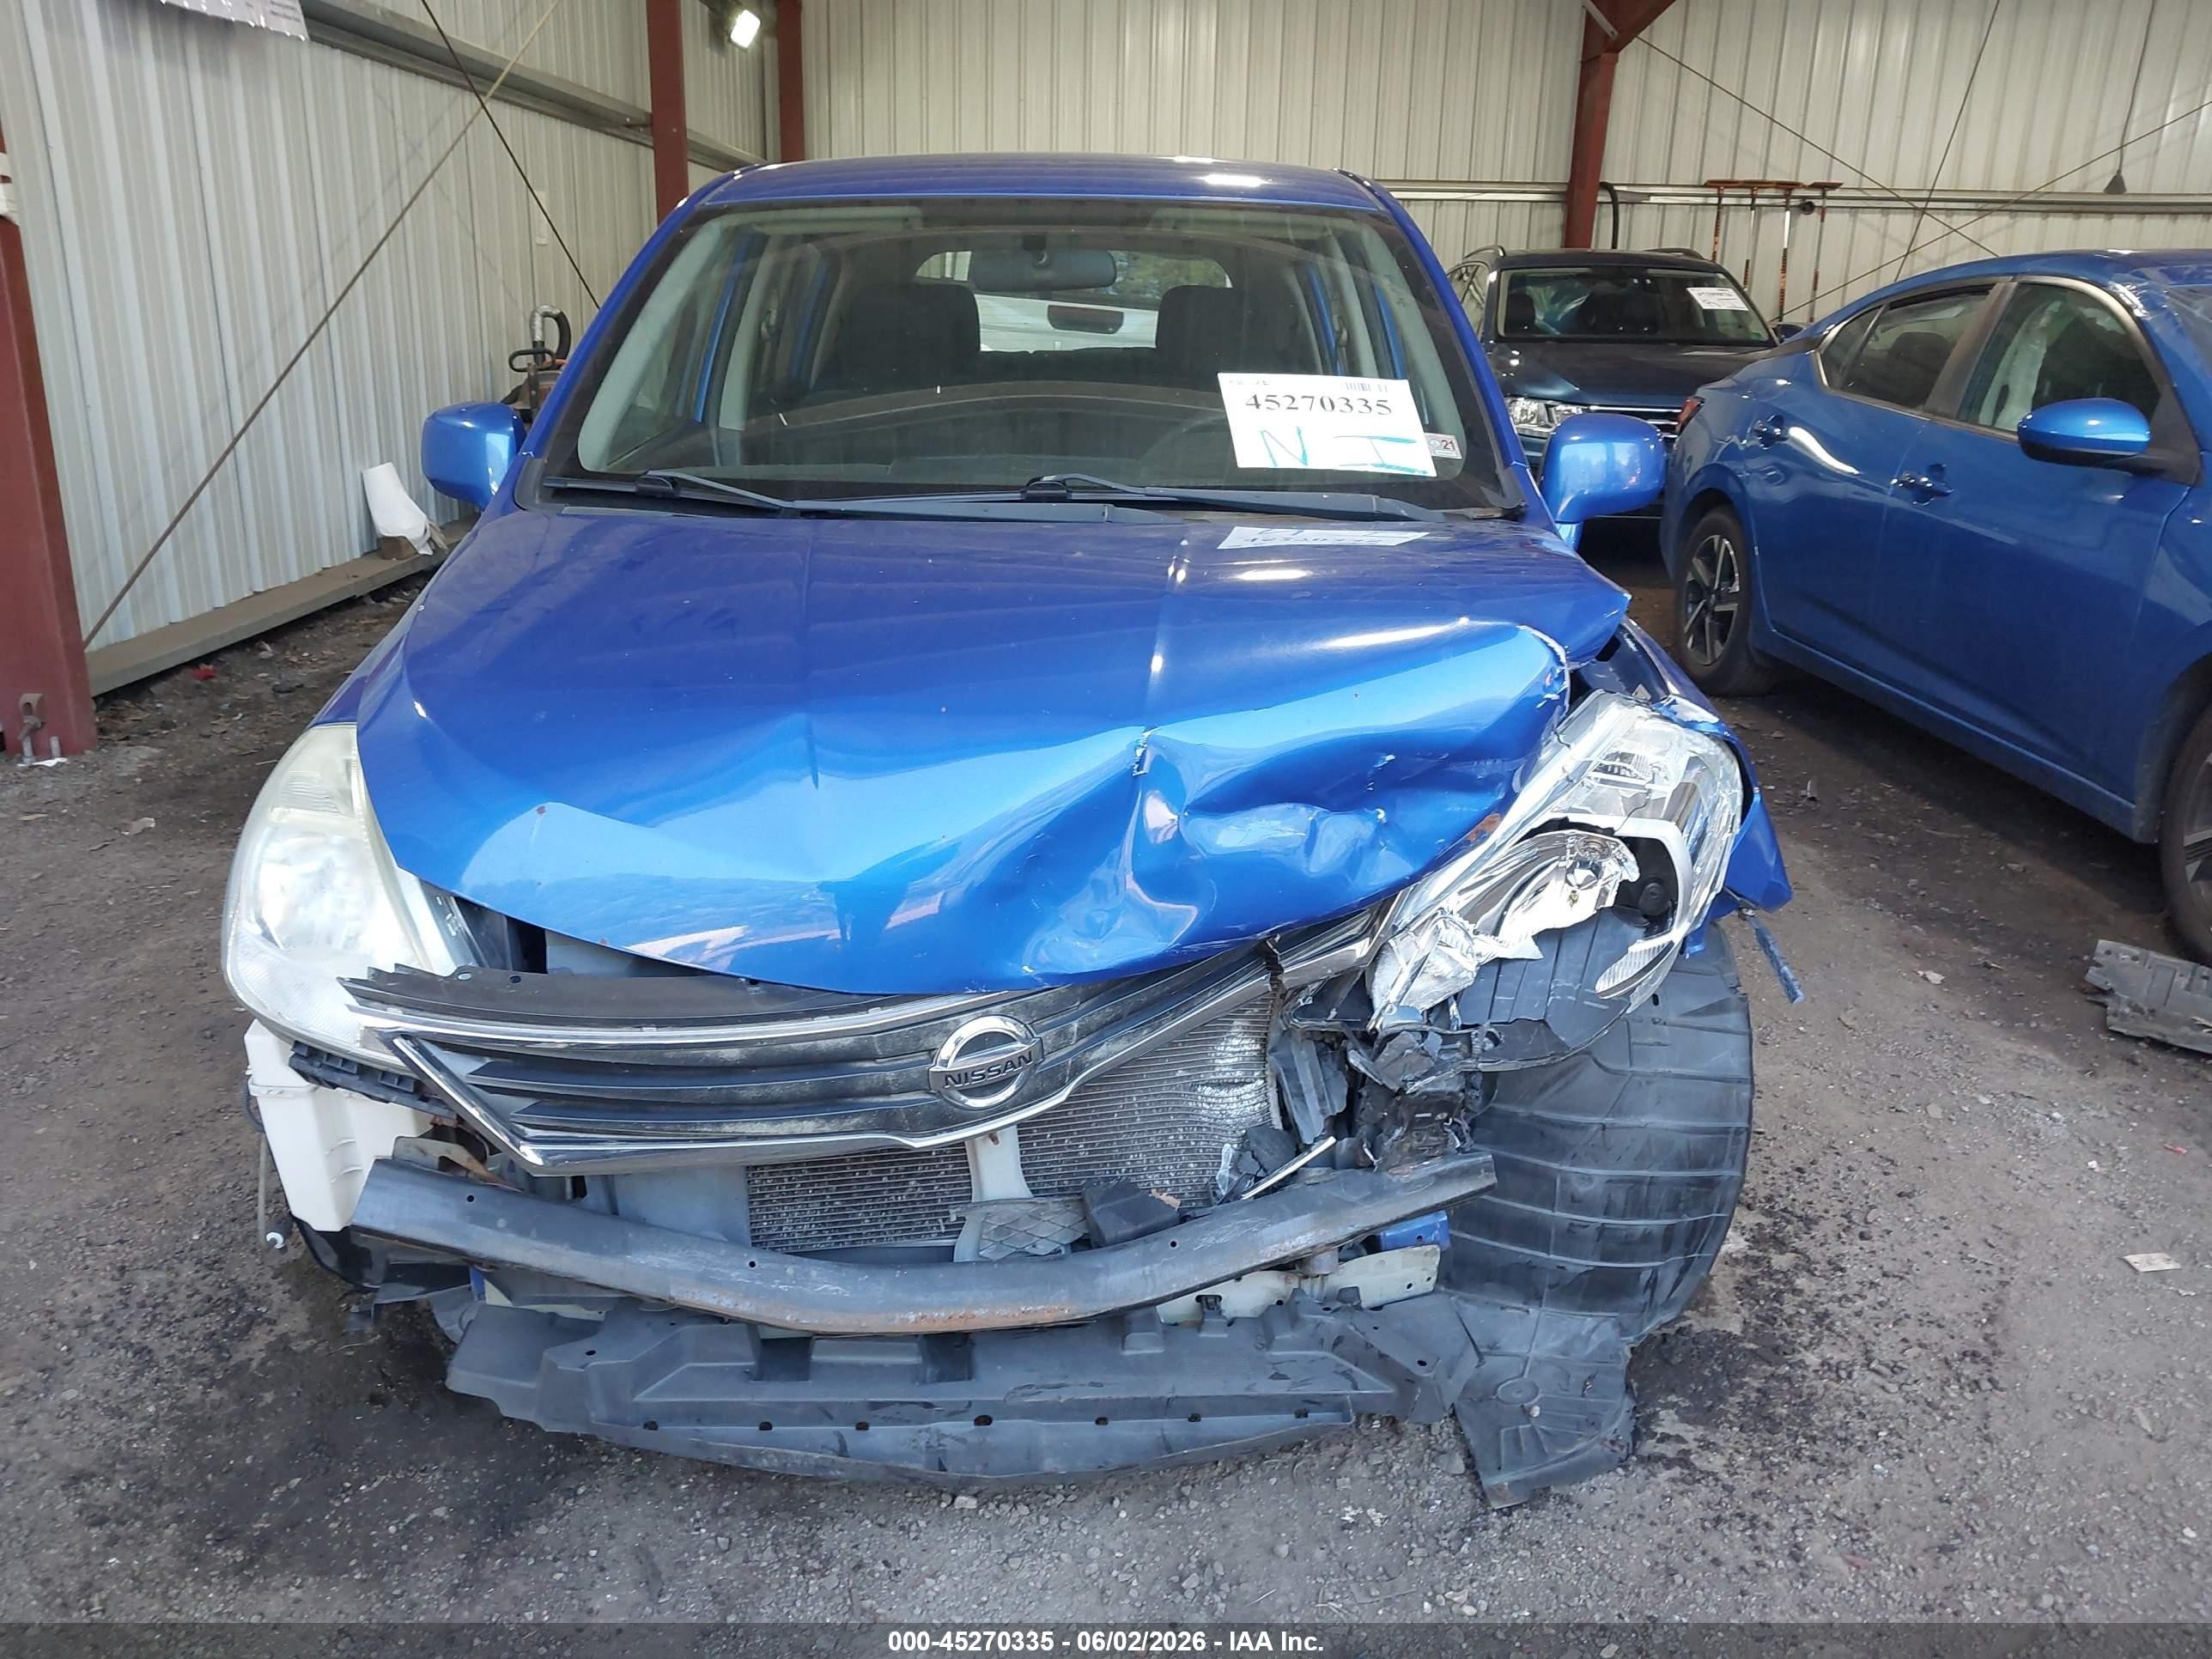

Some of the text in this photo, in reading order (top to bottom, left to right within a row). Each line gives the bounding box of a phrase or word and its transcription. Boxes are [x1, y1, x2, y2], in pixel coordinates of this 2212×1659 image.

[1245, 393, 1393, 416] 45270335
[1441, 439, 1456, 451] 21
[944, 1050, 1033, 1088] NISSAN
